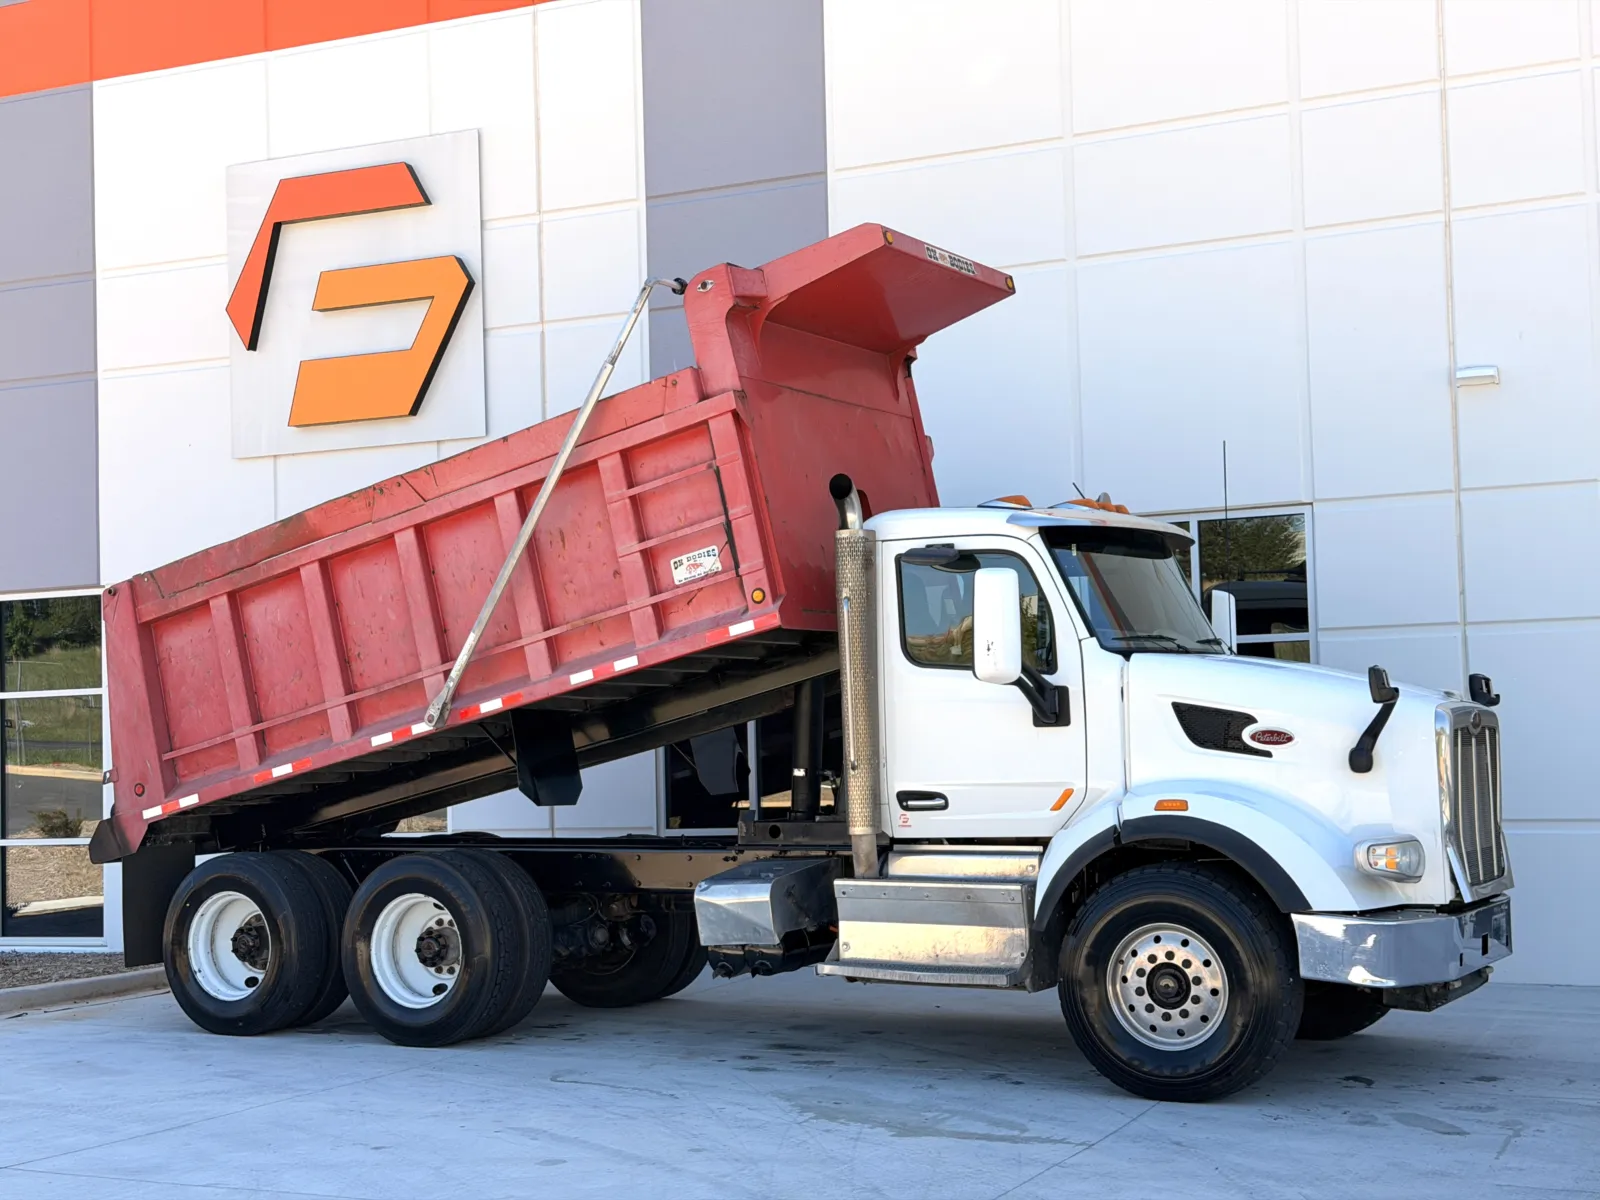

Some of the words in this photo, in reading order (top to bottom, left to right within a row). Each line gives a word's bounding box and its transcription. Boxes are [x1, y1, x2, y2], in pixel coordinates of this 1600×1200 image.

[947, 254, 975, 274] BODIES
[686, 548, 717, 562] BODIES
[1255, 731, 1290, 742] Peterbilt
